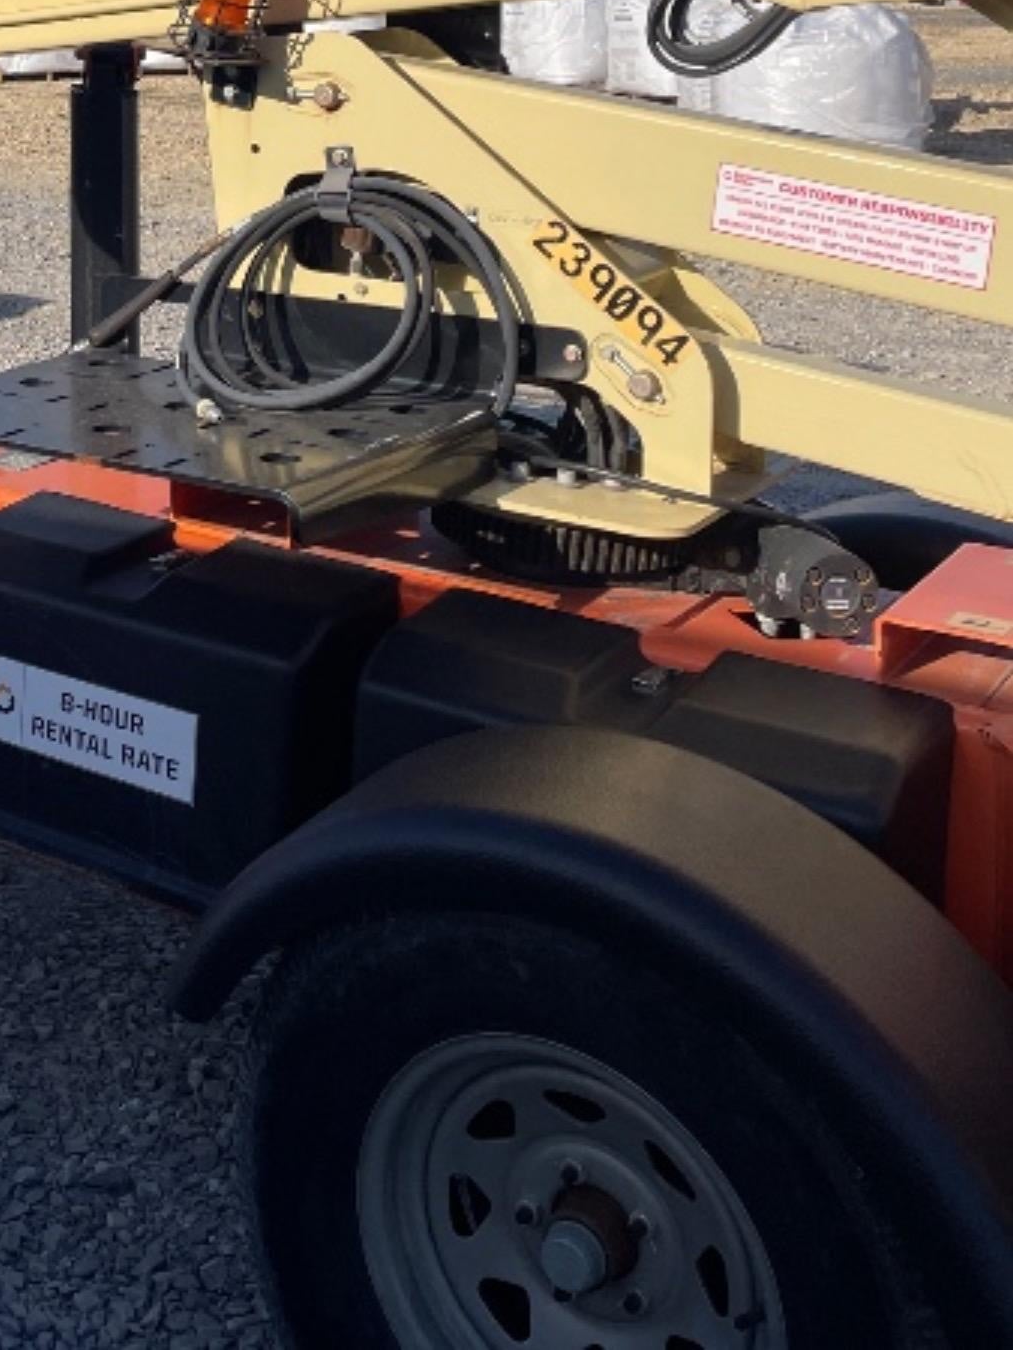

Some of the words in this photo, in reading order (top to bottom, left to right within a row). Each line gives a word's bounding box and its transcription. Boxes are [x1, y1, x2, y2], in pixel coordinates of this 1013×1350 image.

[532, 220, 691, 366] 239094
[30, 715, 114, 760] RENTAL
[120, 743, 181, 781] RATE
